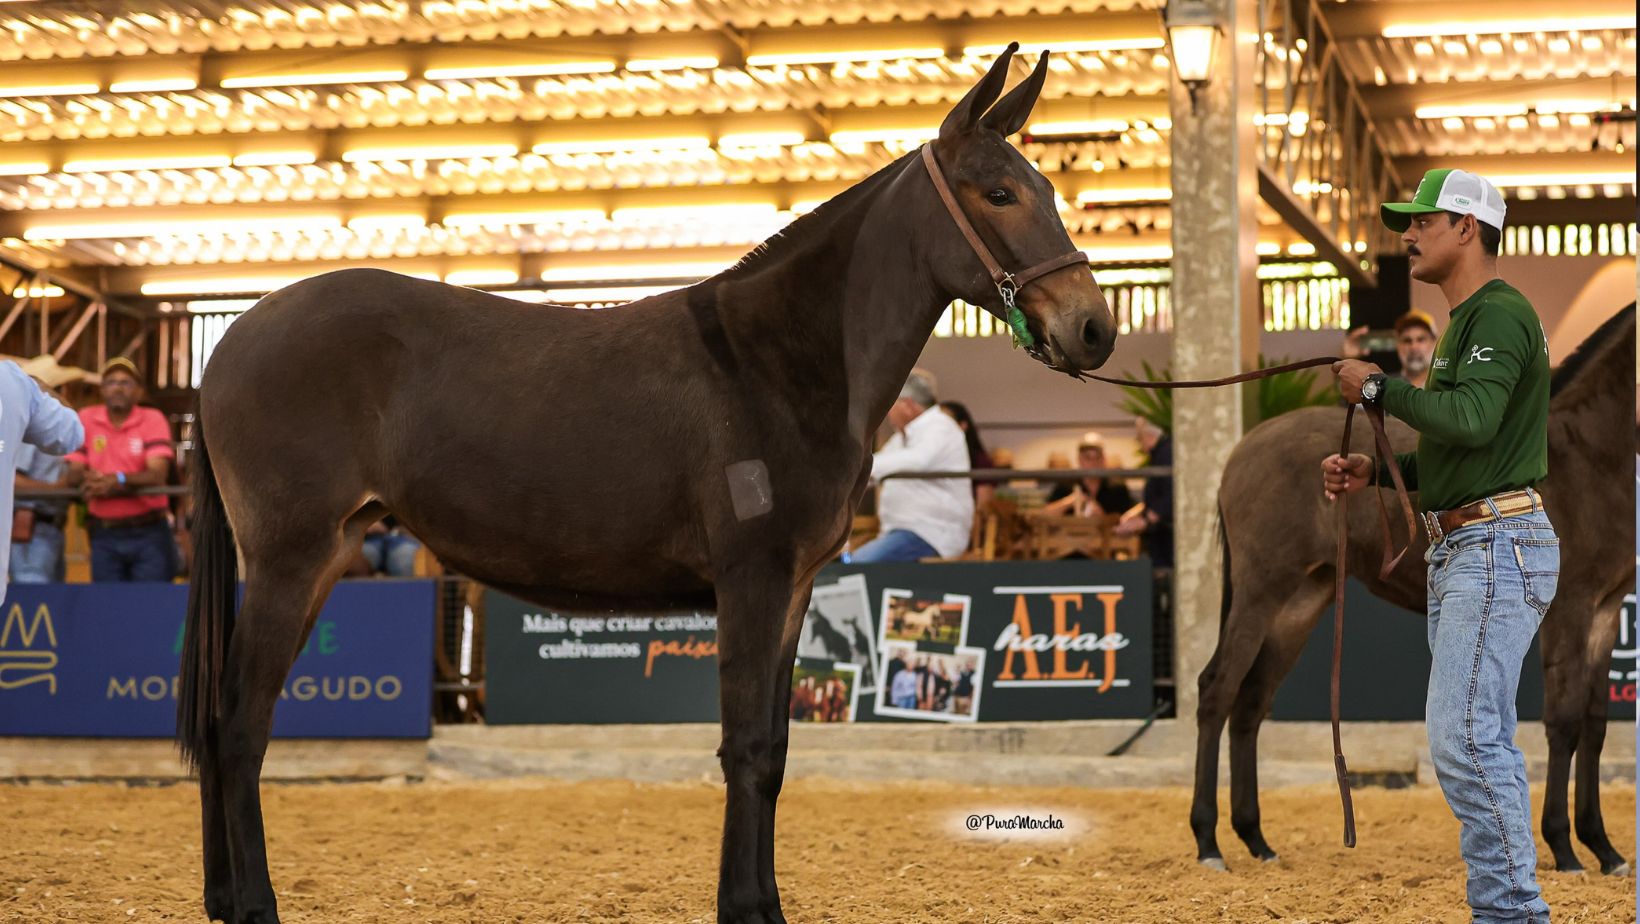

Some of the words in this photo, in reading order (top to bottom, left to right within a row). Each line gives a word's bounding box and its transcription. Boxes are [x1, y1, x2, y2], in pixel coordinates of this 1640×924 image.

[522, 613, 568, 633] Mais
[569, 617, 605, 637] que
[606, 615, 653, 632] criar
[993, 622, 1130, 651] haras
[539, 638, 641, 659] cultivamos
